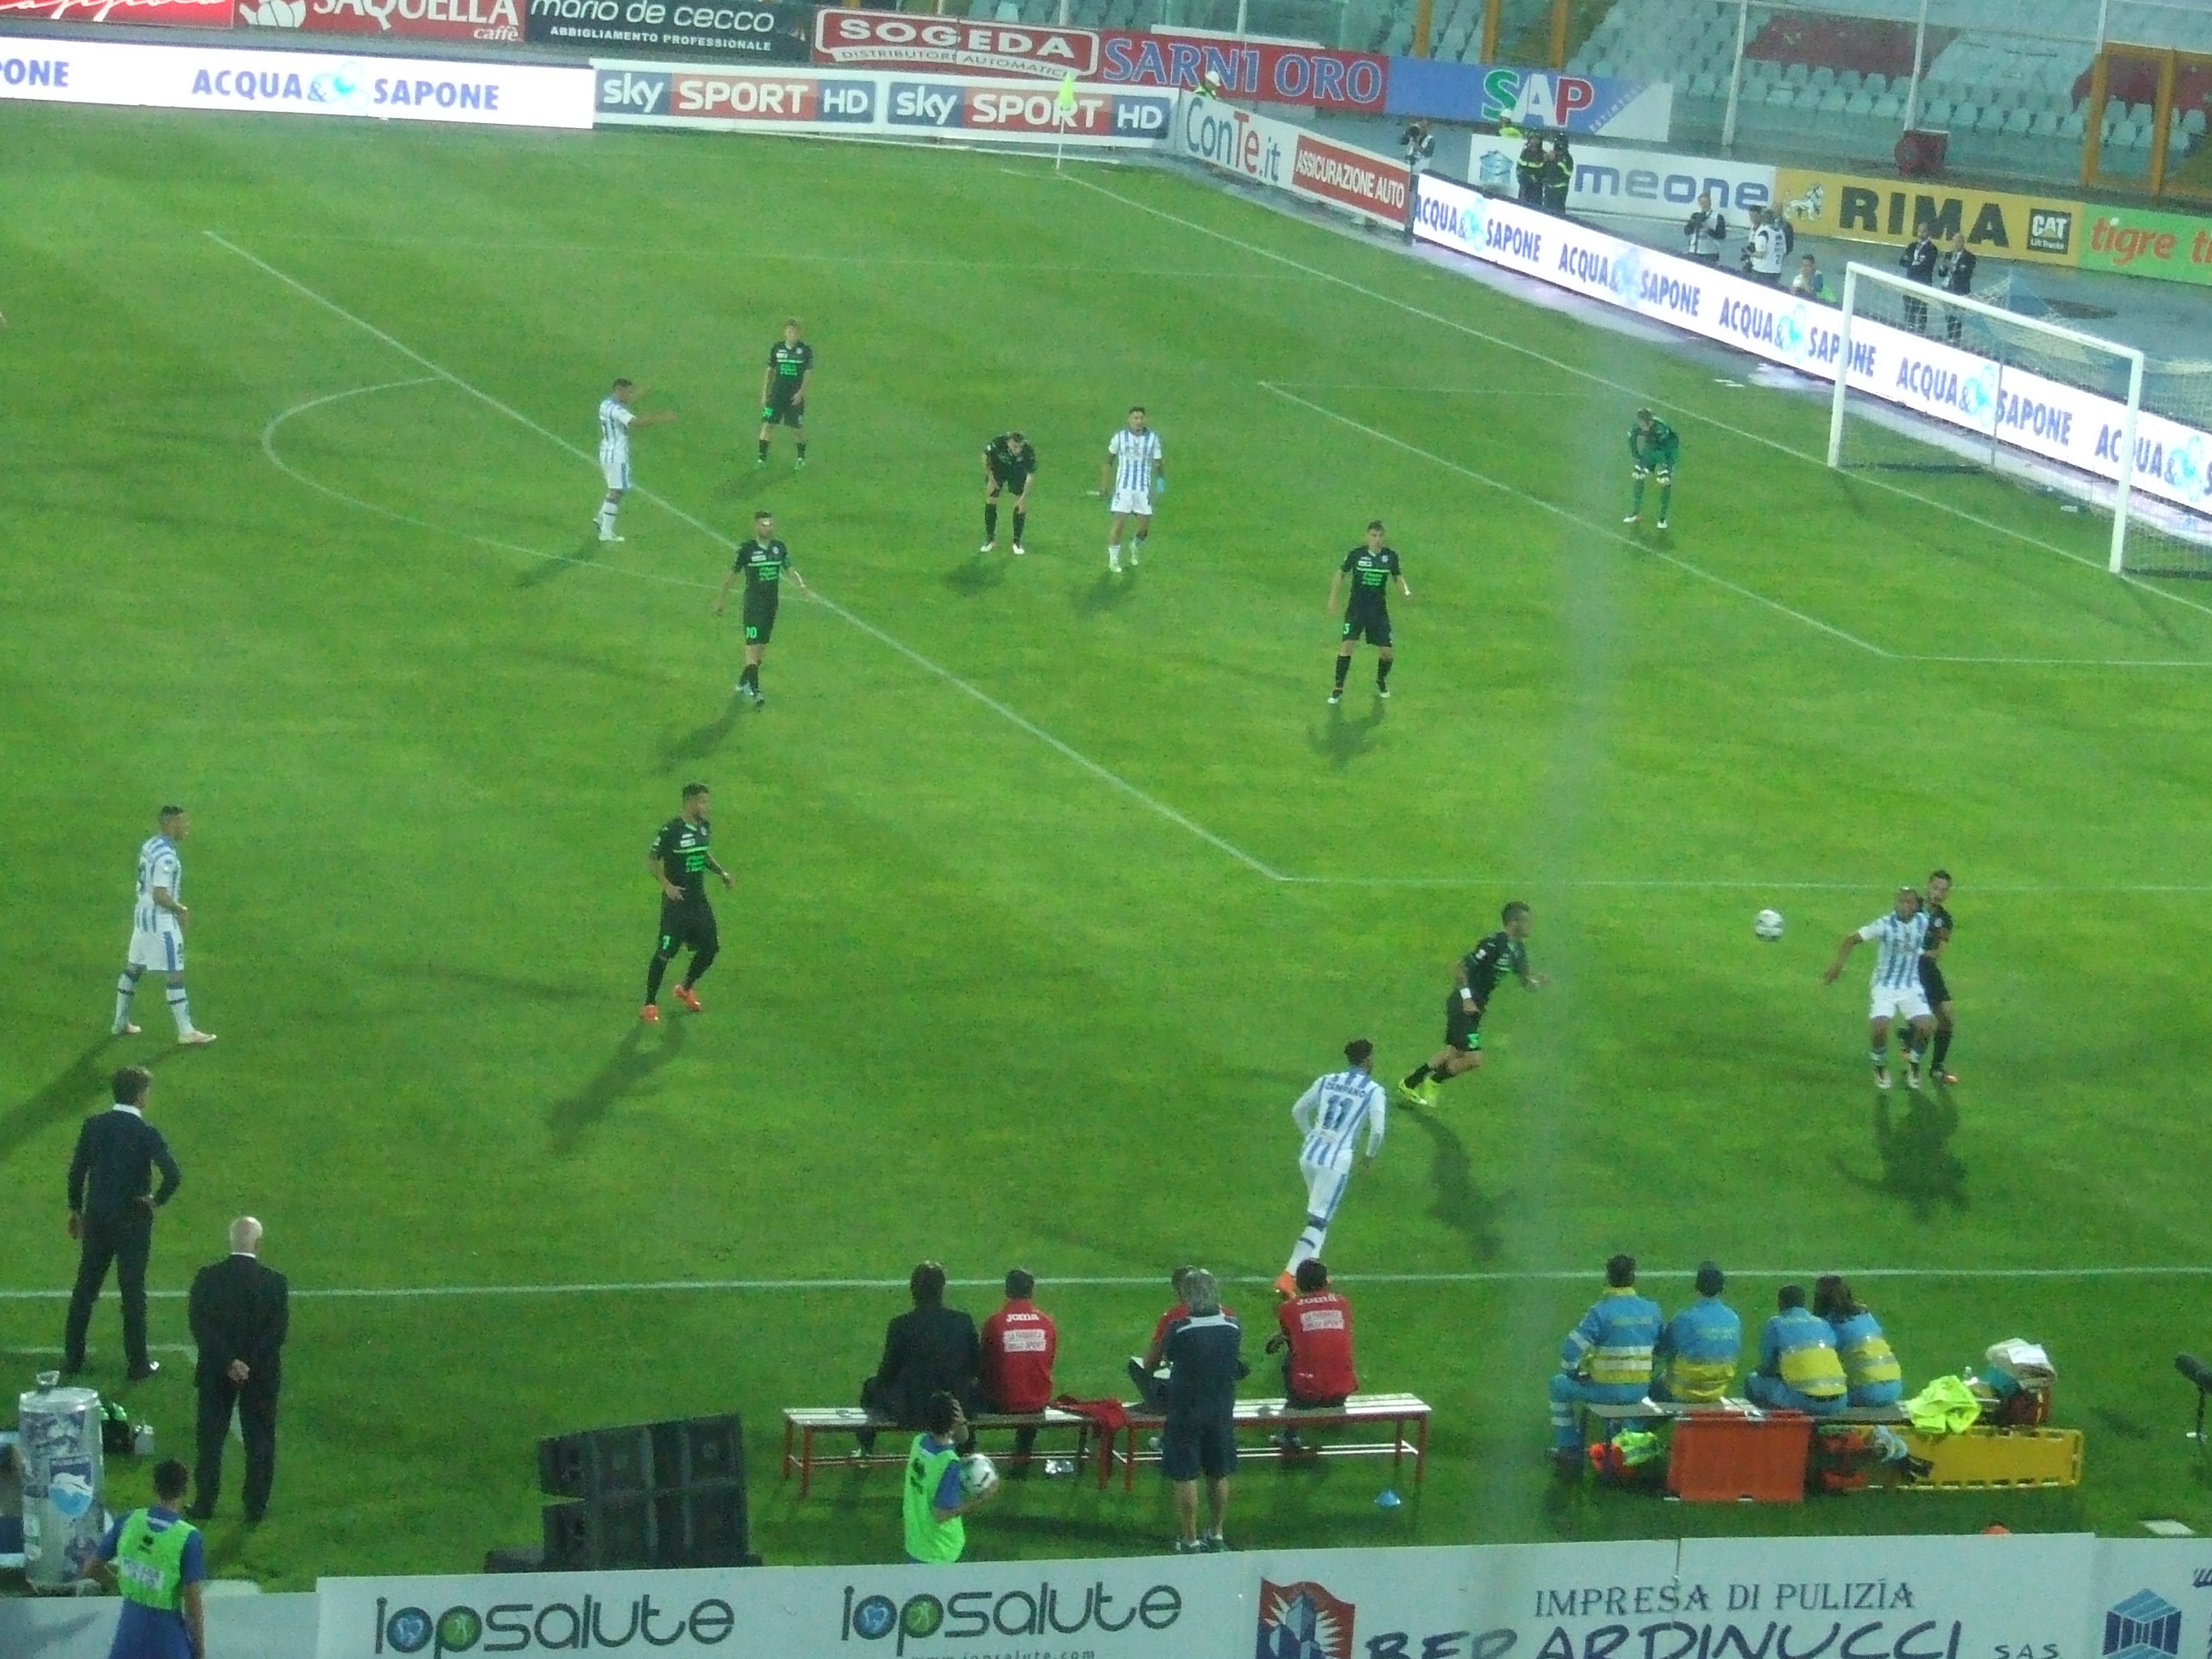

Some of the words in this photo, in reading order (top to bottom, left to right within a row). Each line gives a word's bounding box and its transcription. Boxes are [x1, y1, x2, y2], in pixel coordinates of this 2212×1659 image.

[550, 26, 658, 43] ABBIGLIAMENTO
[663, 34, 771, 51] PROFESSIONALE
[626, 0, 666, 24] de
[673, 6, 774, 32] cecco
[839, 19, 1075, 59] SOGEDA
[0, 58, 69, 87] ONE
[192, 69, 302, 102] ACQUA
[374, 79, 499, 110] SAPONE
[603, 73, 664, 114] sky
[679, 79, 809, 115] SPORT
[823, 89, 869, 114] HD
[1103, 38, 1260, 93] SARNI
[1274, 54, 1382, 103] ORO
[896, 85, 958, 125] sky
[972, 94, 1103, 128] SPORT
[1119, 98, 1162, 131] HD
[1481, 68, 1595, 127] SAP
[1186, 97, 1282, 183] ConTe.it
[1295, 149, 1376, 199] ASSICURAZIONE
[1376, 177, 1405, 209] AUTO
[1414, 194, 1458, 235] ACQUA
[1486, 218, 1541, 262] SAPONE
[1839, 185, 2010, 248] RIMA
[2032, 214, 2067, 240] CAT
[2091, 217, 2176, 266] tigre
[1557, 242, 1610, 288] ACQUA
[1639, 271, 1701, 317] SAPONE
[1719, 296, 1773, 343] ACQUA
[1895, 357, 1959, 406] ACQUA
[1995, 388, 2073, 446] SAPONE
[2094, 423, 2163, 479] ACUA
[375, 1593, 735, 1659] iopsalute
[841, 1581, 1182, 1656] iopsalute
[1534, 1584, 1710, 1617] IMPRESA
[1726, 1583, 1760, 1611] DI
